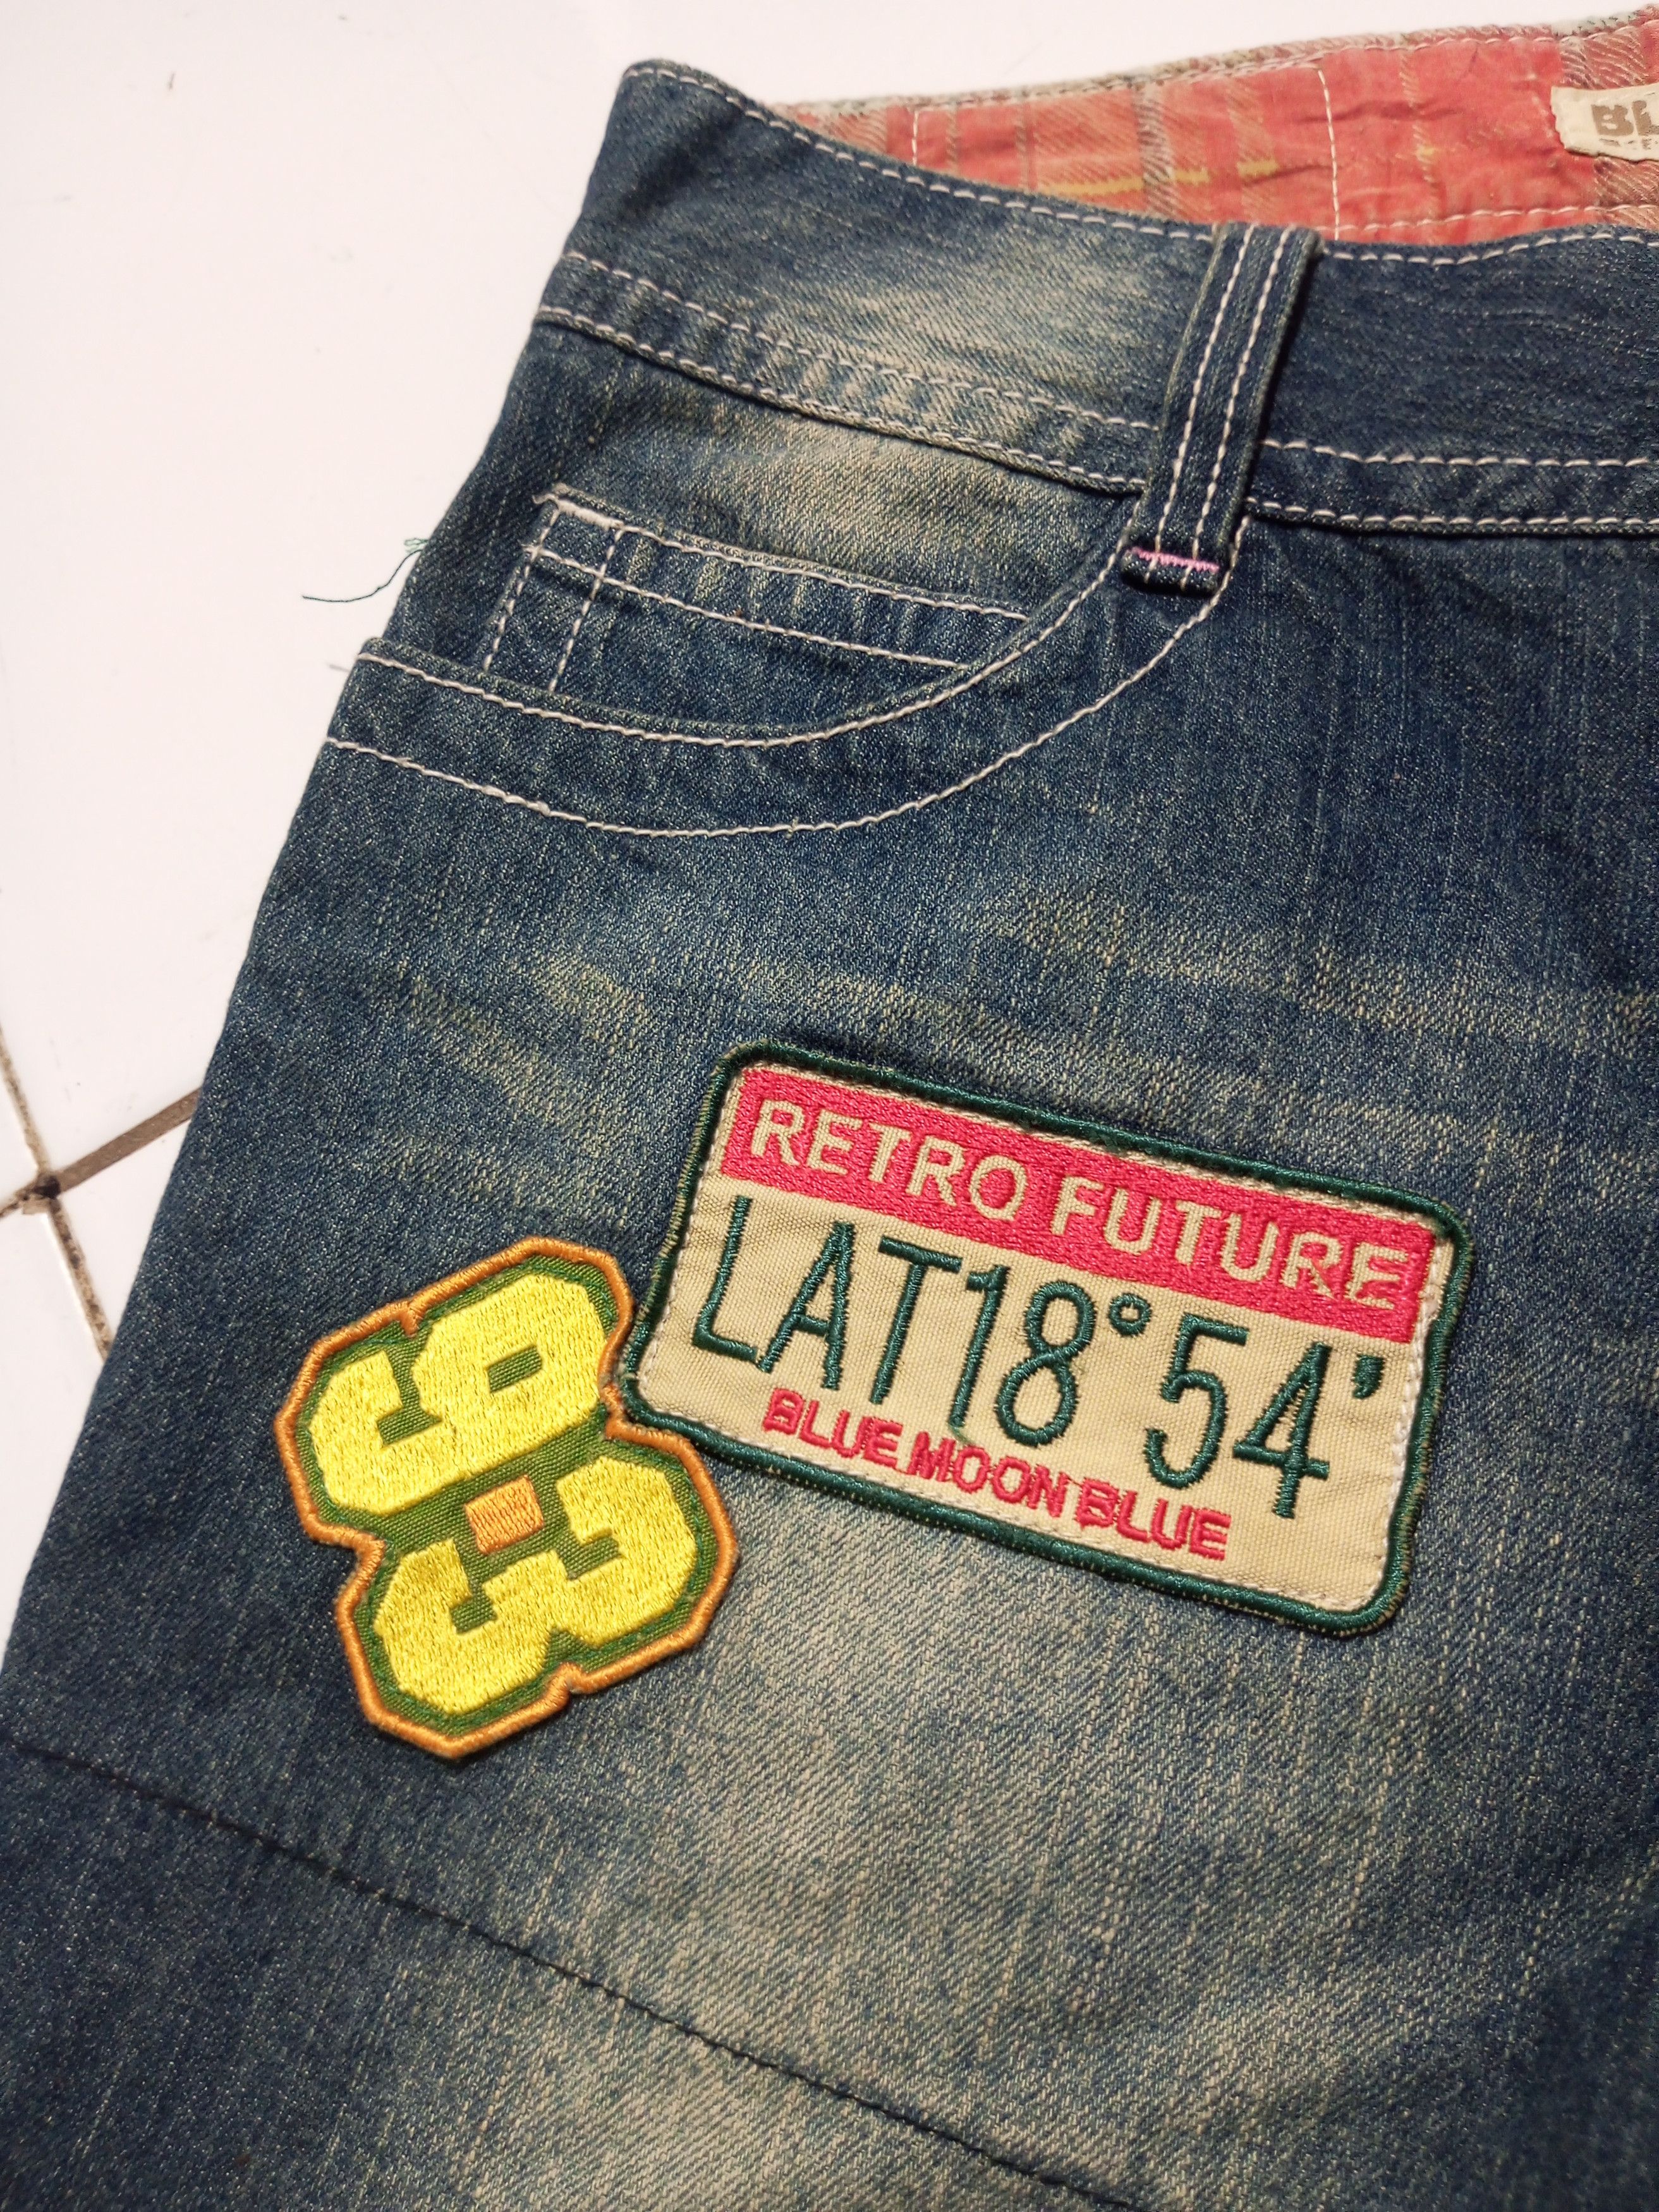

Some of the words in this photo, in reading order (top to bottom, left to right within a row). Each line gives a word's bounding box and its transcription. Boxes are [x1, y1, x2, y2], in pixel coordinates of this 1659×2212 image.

[750, 1098, 1027, 1220] RETRO
[1050, 1176, 1407, 1311] FUTURE
[762, 1387, 904, 1468] BLUE
[905, 1430, 1071, 1517] MOON
[1075, 1476, 1232, 1561] BLUE
